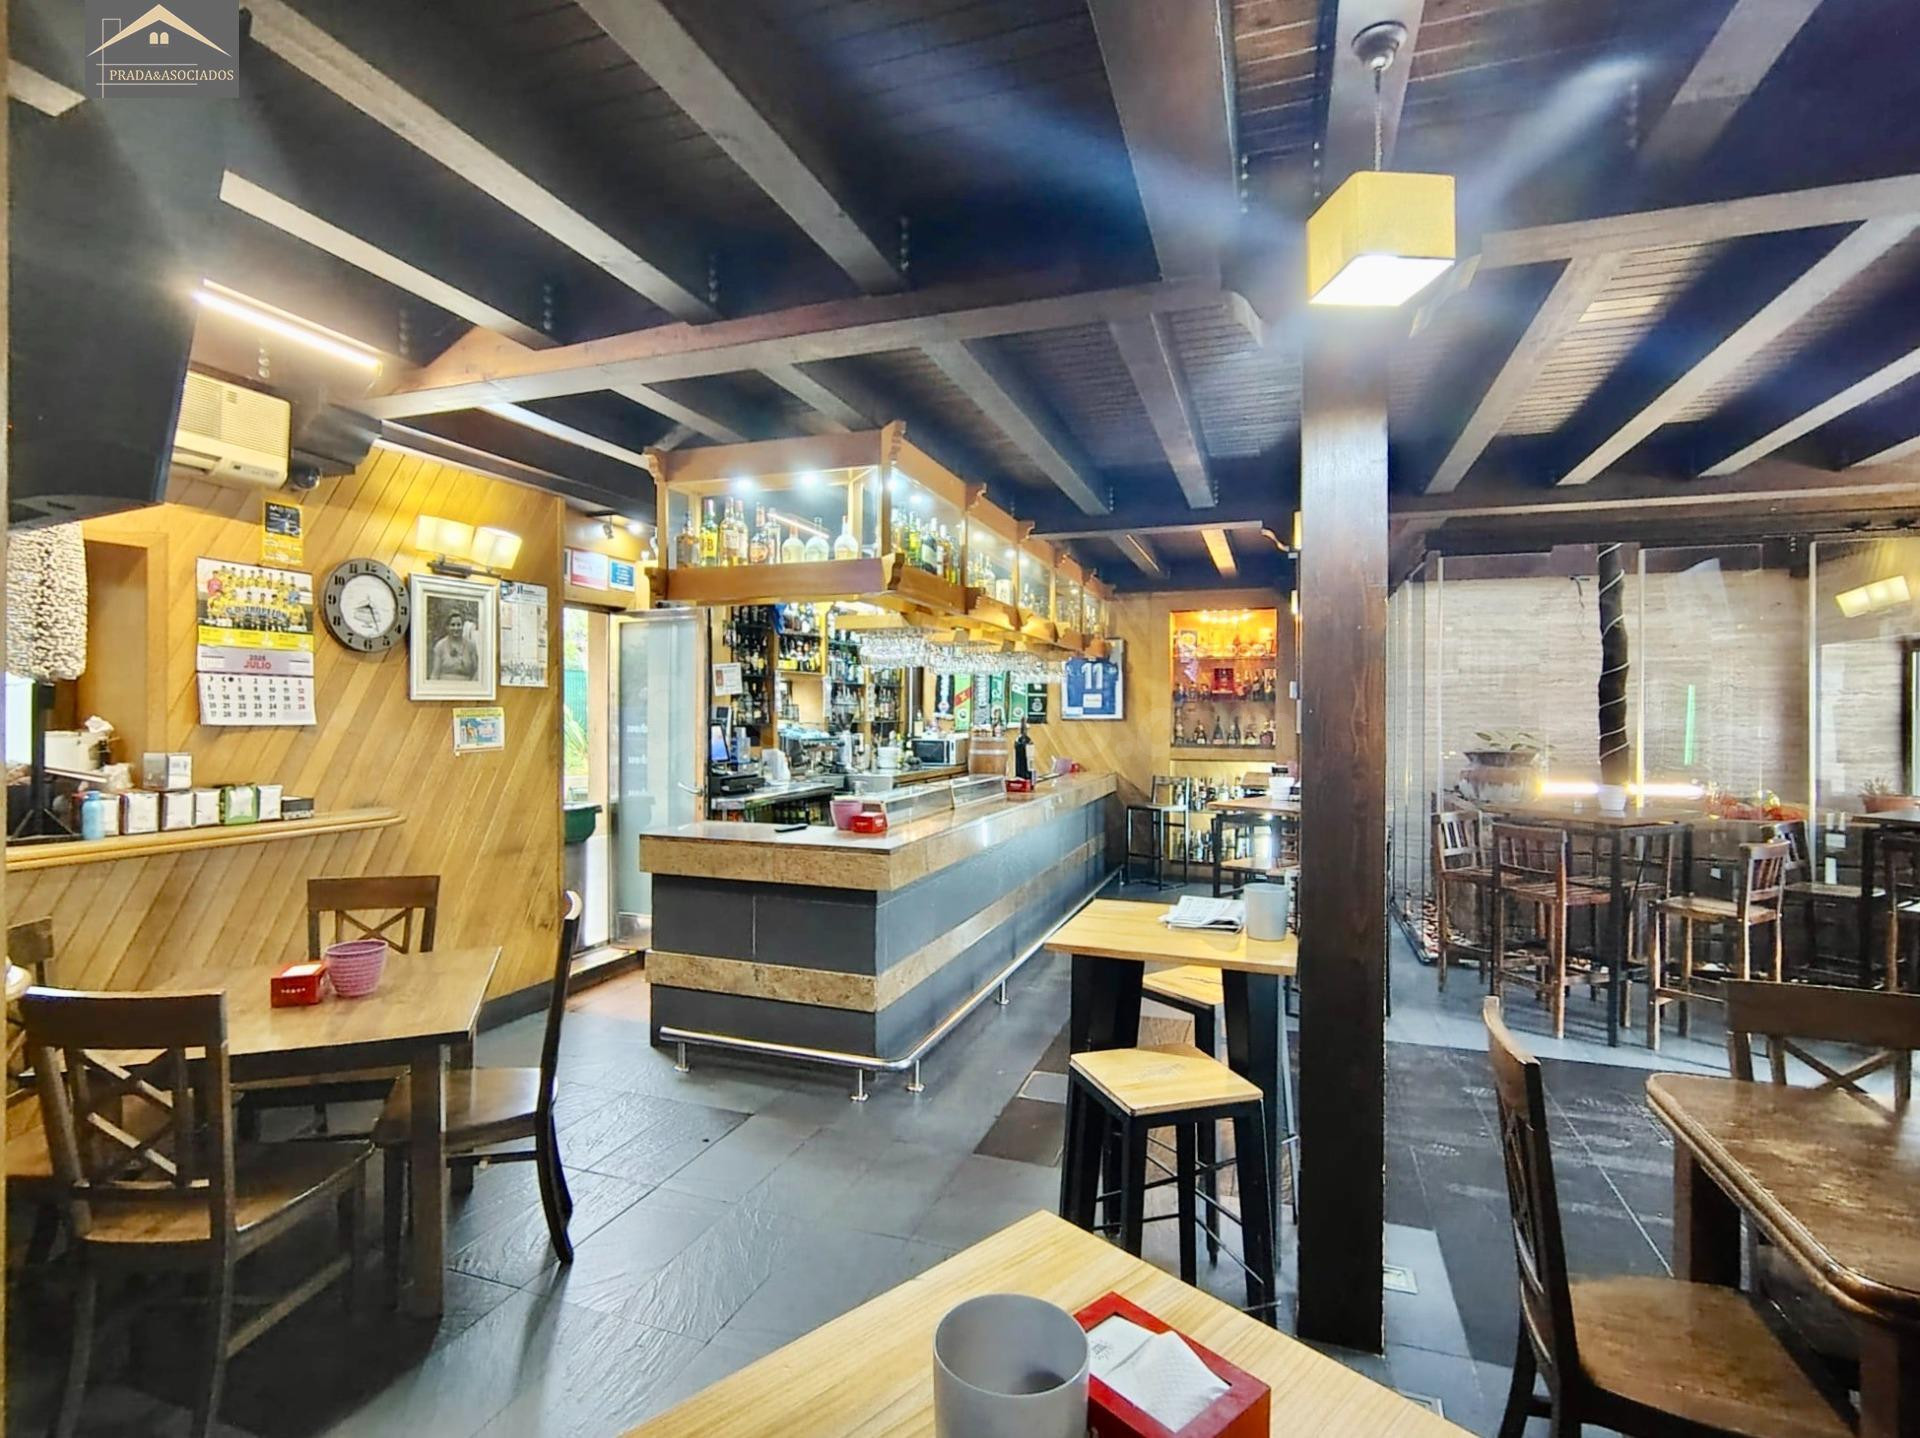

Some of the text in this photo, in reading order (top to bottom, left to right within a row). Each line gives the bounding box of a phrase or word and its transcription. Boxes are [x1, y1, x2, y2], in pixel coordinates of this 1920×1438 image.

[334, 575, 345, 586] 10
[398, 586, 405, 597] 2
[328, 594, 336, 605] 9
[400, 606, 408, 616] 3
[333, 616, 341, 626] 8
[395, 624, 402, 634] 4
[363, 640, 373, 650] 6
[243, 660, 272, 670] JULIO
[1081, 662, 1103, 689] 11
